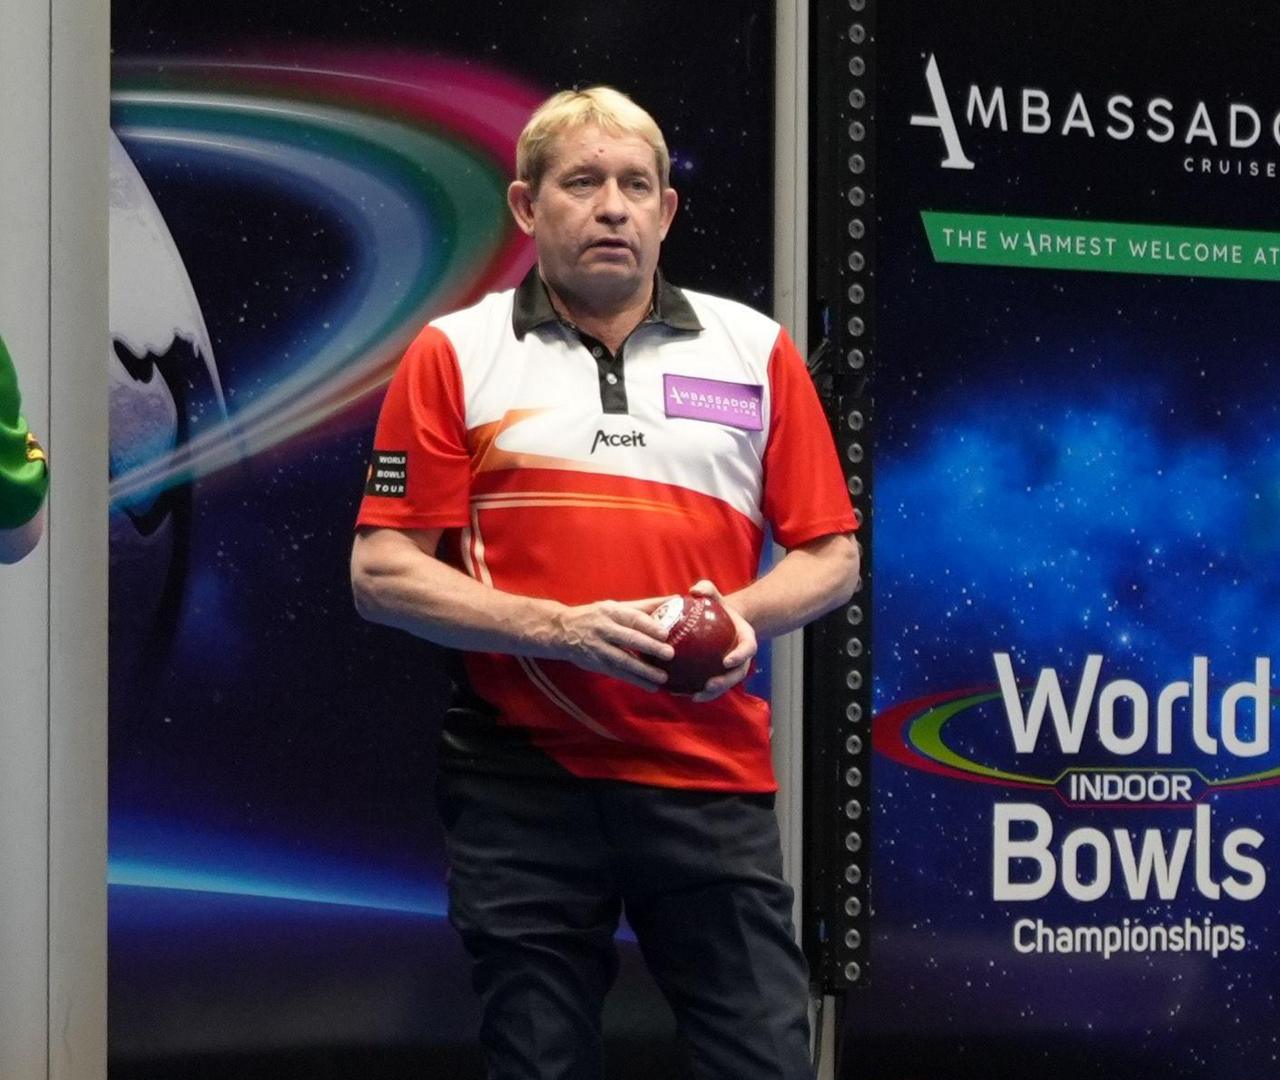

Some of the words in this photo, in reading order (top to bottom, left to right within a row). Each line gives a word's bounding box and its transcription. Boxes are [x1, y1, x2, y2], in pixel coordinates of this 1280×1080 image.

[1183, 157, 1277, 178] CRUISE
[943, 228, 987, 249] THE
[1000, 230, 1117, 256] WARMEST
[1129, 240, 1242, 263] WELCOME
[1253, 247, 1280, 266] AT
[590, 429, 647, 454] Aceit
[378, 455, 406, 465] WORLD
[377, 470, 406, 479] BOWLS
[375, 483, 404, 493] TOUR
[993, 653, 1270, 757] World
[1071, 774, 1192, 801] INDOOR
[993, 803, 1266, 901] Bowls
[1014, 917, 1246, 959] Championships
